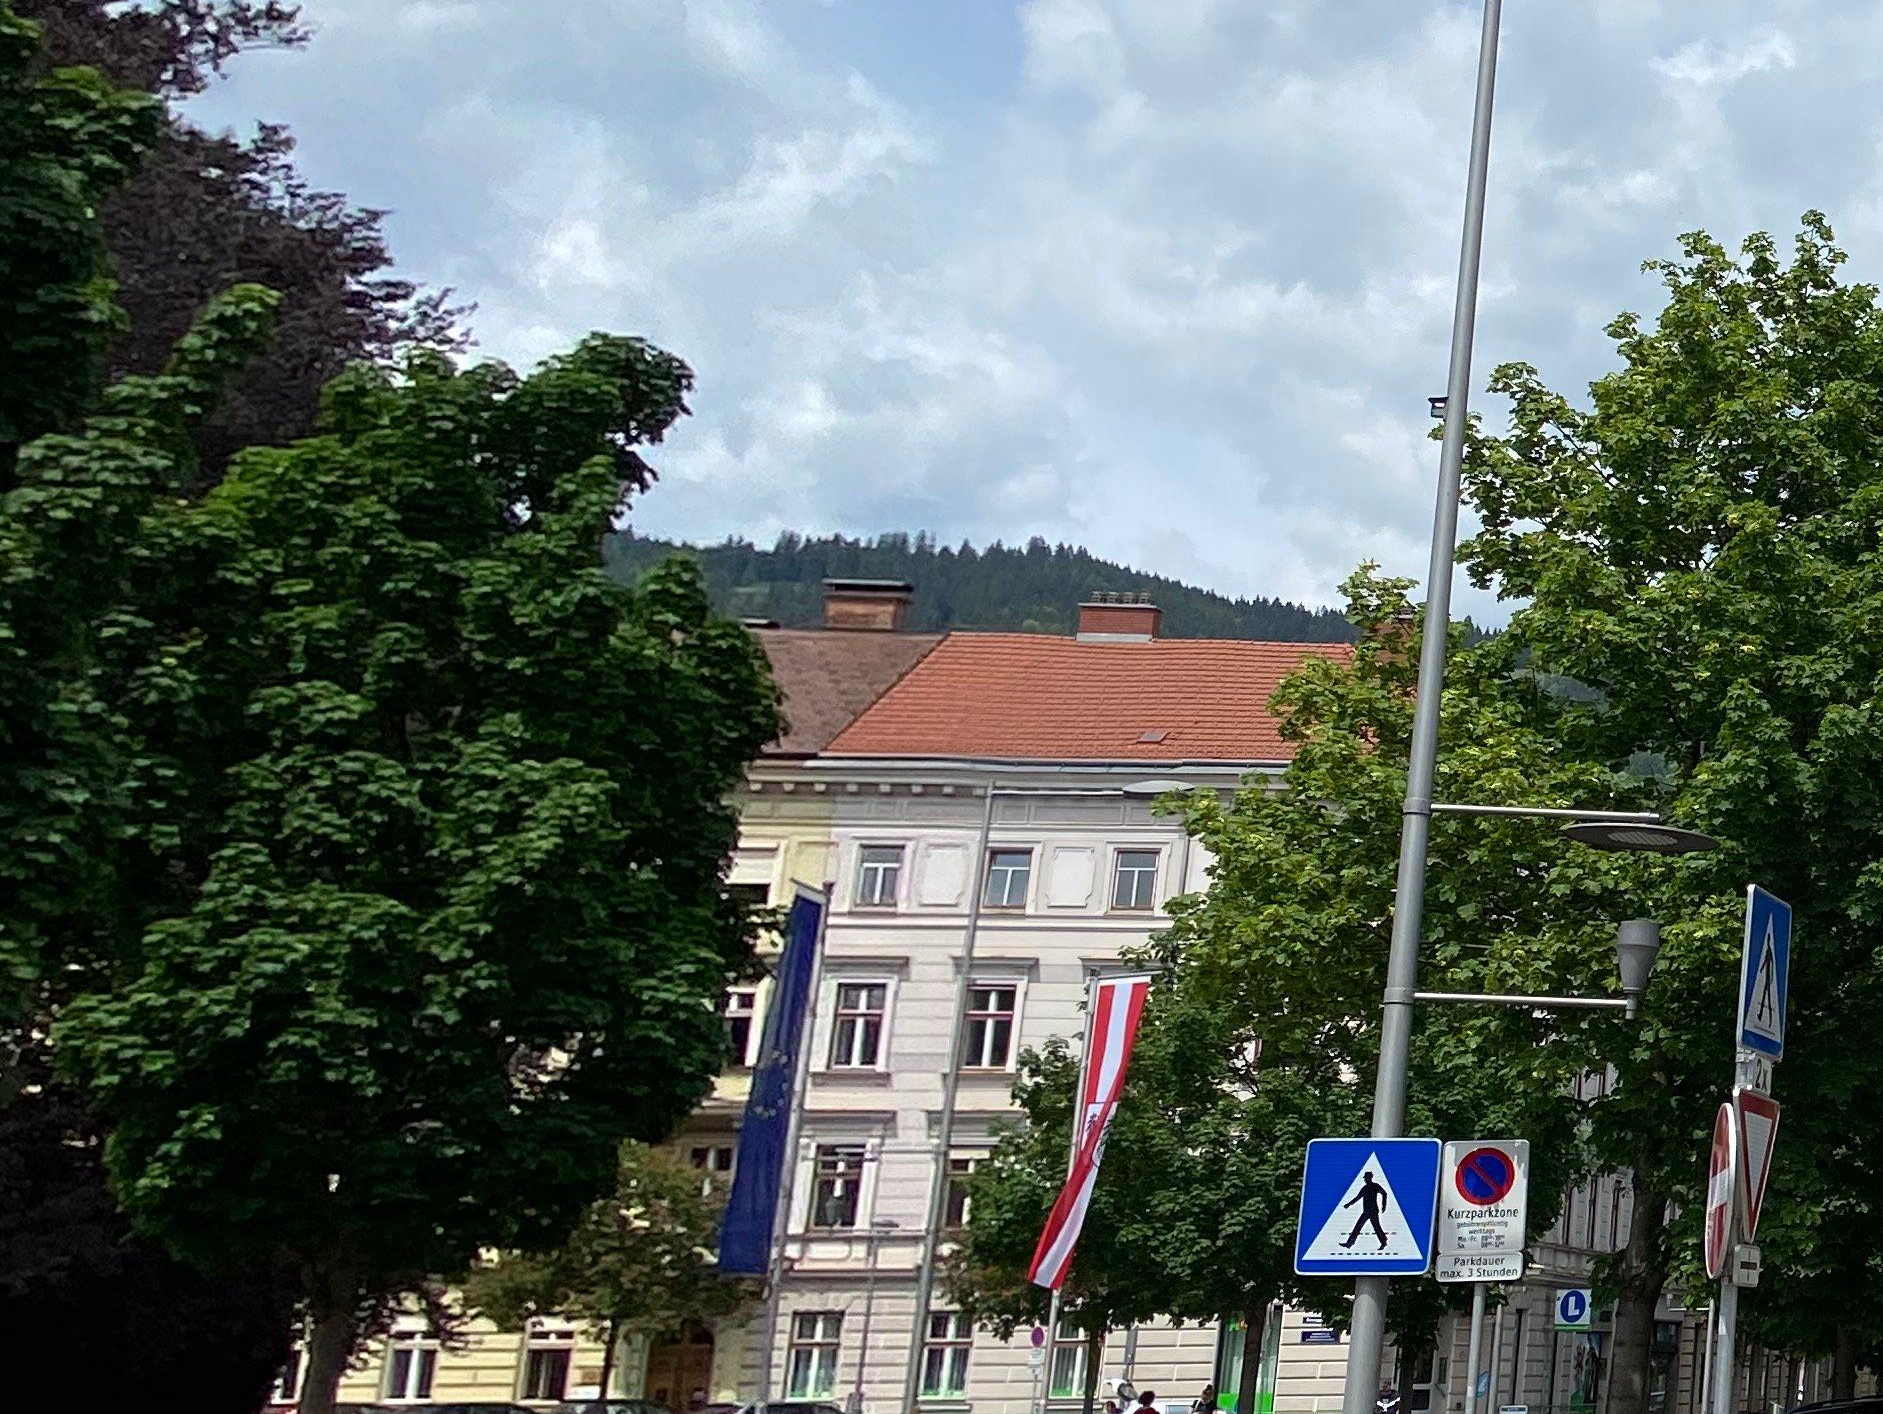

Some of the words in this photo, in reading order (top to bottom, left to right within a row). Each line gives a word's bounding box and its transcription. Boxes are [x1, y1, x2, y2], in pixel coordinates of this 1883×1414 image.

[1447, 1207, 1519, 1221] Kurzparkzone
[1453, 1257, 1506, 1267] Parkdauer
[1467, 1268, 1474, 1278] 3
[1476, 1268, 1518, 1278] Stunden
[1567, 1296, 1580, 1317] L
